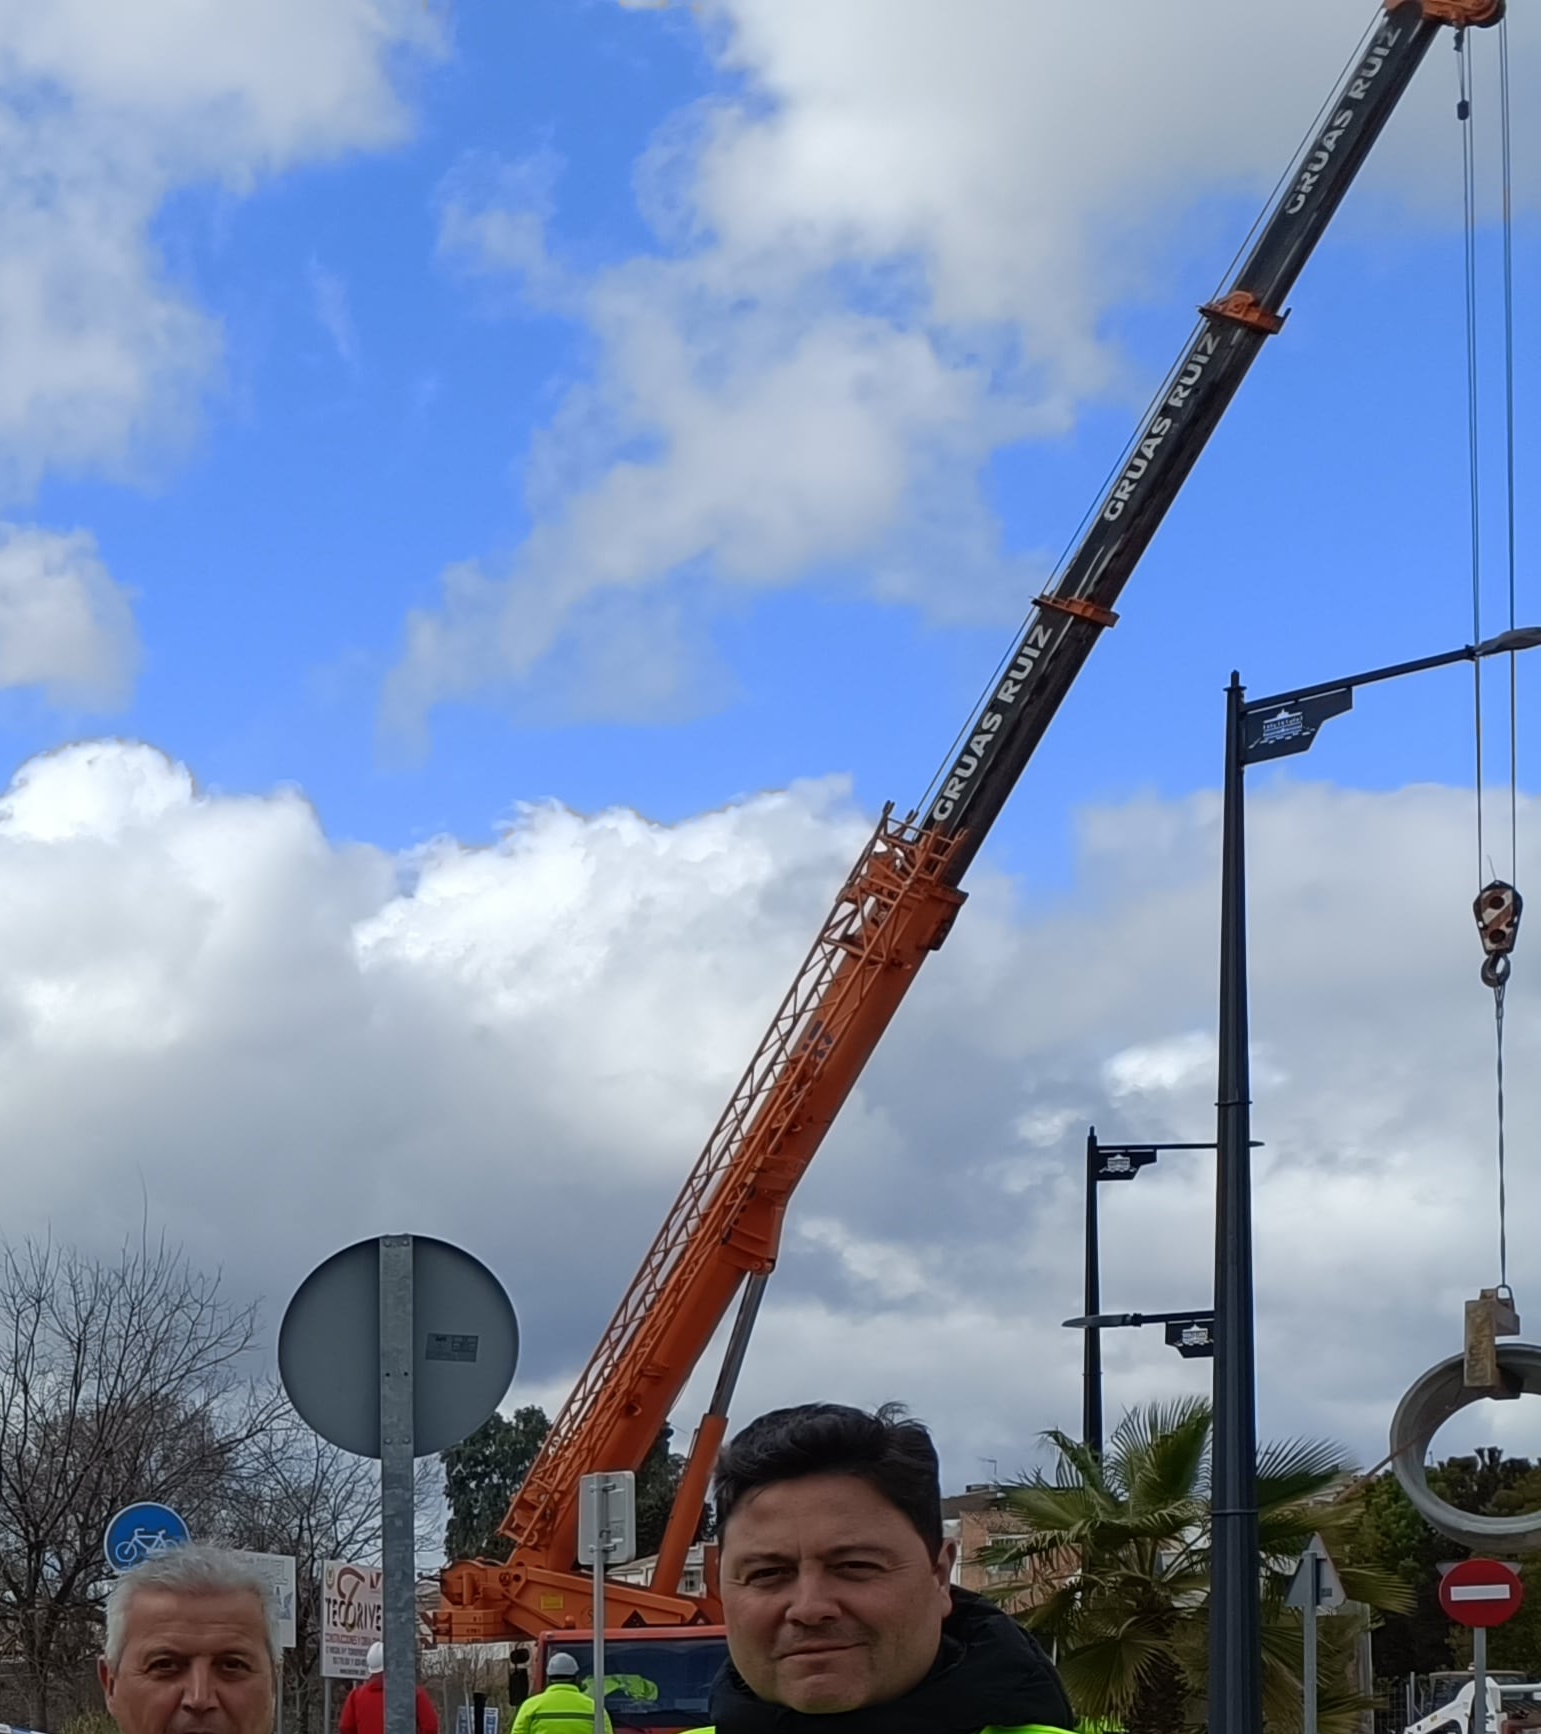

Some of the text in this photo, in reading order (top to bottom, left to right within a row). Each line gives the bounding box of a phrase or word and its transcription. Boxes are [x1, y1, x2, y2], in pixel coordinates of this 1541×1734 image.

[1284, 26, 1401, 214] GRUAS RUIZ
[1103, 332, 1220, 522] GRUAS RUIZ
[933, 624, 1053, 821] GRUAS RUIZ
